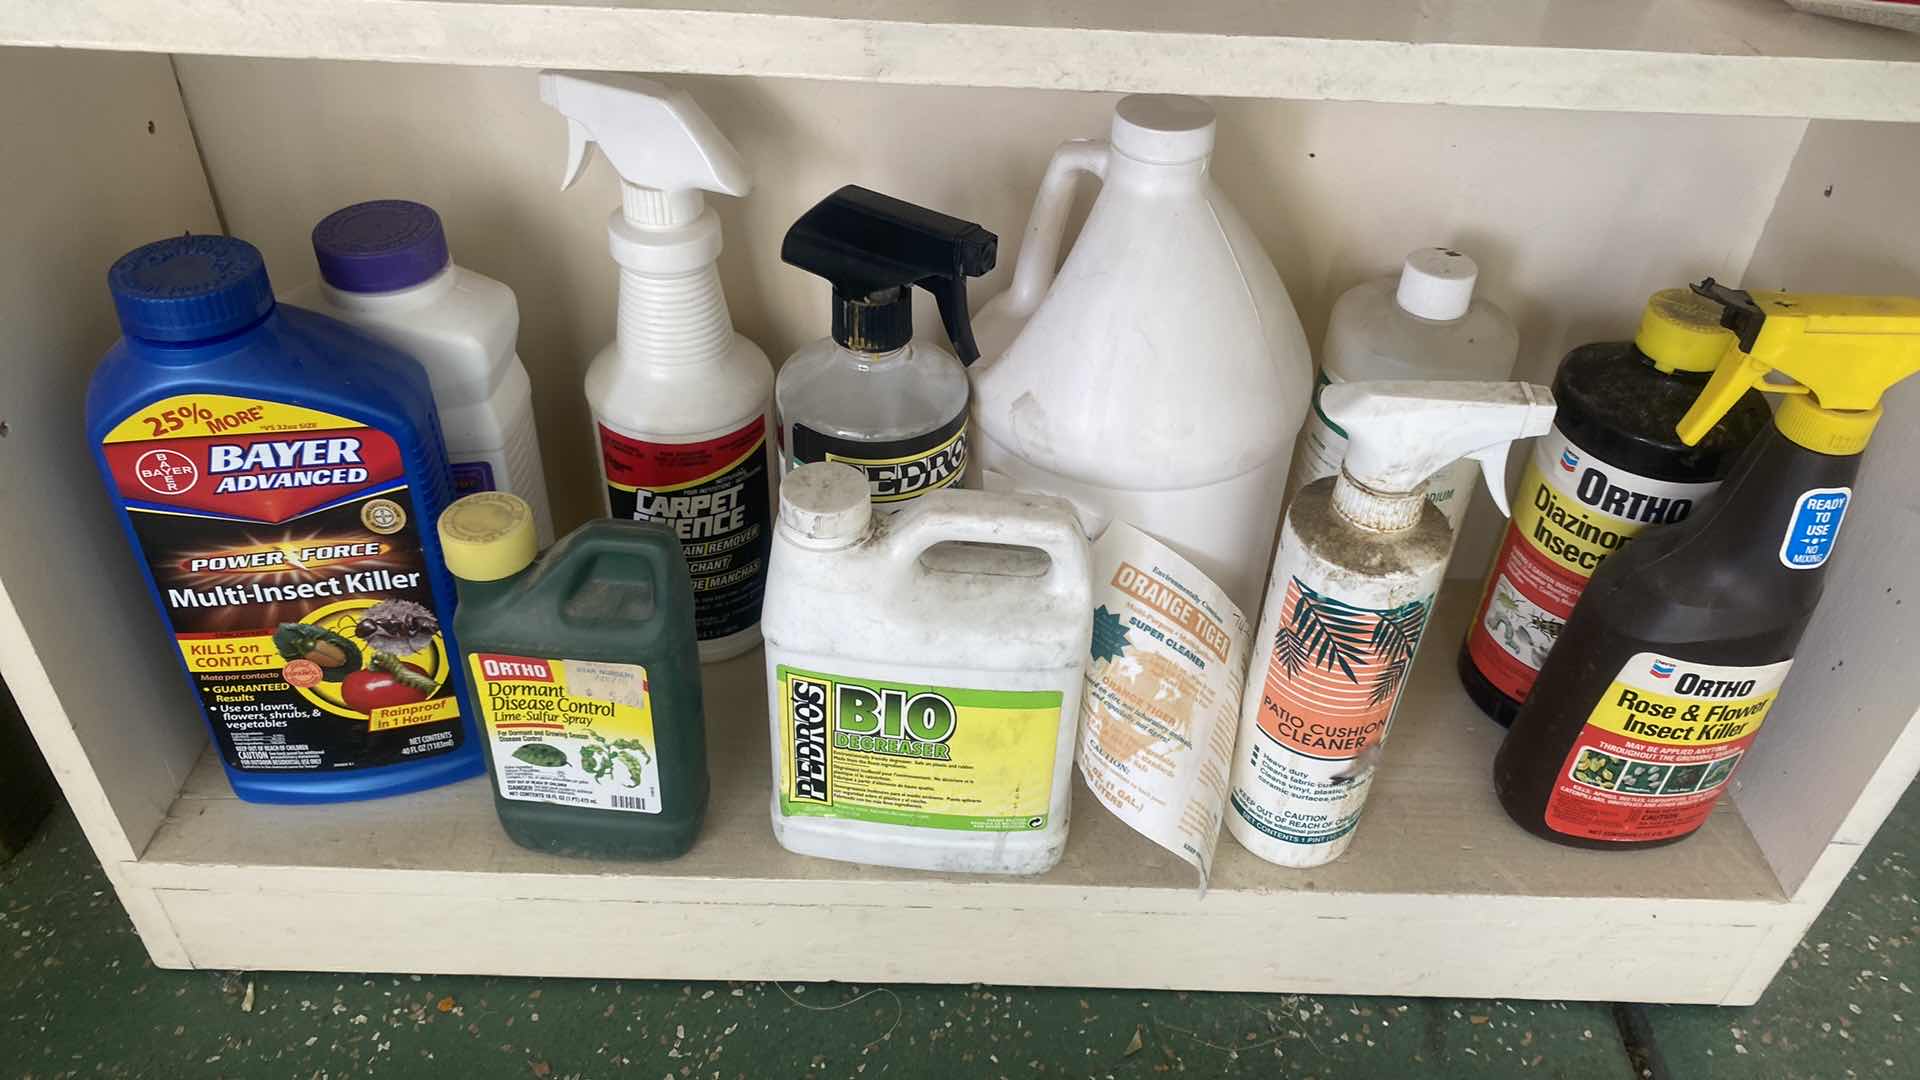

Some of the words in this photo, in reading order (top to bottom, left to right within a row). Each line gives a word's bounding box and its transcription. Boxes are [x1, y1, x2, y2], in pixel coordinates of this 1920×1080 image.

[143, 402, 213, 437] 25%
[209, 438, 361, 475] BAYER
[141, 466, 193, 478] BAYER
[156, 453, 178, 490] BAYER
[216, 468, 368, 494] ADVANCED
[636, 483, 745, 518] CARPET
[1576, 467, 1693, 525] ORTHO
[1806, 497, 1846, 510] READY
[1815, 512, 1831, 523] TO
[1806, 524, 1831, 536] USE
[191, 551, 285, 572] POWER
[301, 543, 380, 561] FORCE
[1792, 554, 1824, 563] MIXING
[1806, 546, 1820, 554] NO
[168, 577, 342, 608] Multi-Insect
[347, 570, 421, 593] Killer
[1118, 567, 1194, 625] ORANGE
[191, 644, 235, 656] KILLS
[239, 645, 260, 654] on
[1128, 616, 1165, 642] SUPER
[1166, 638, 1207, 670] CLEANER
[195, 654, 273, 668] CONTACT
[482, 659, 547, 678] ORTHO
[241, 672, 279, 680] contacto
[1674, 672, 1756, 698] ORTHO
[212, 682, 290, 694] GUARANTEED
[488, 682, 565, 698] Dormant
[216, 694, 255, 703] Results
[220, 704, 241, 713] Use
[243, 704, 259, 712] on
[260, 702, 298, 712] lawns,
[492, 697, 554, 711] Disease
[557, 697, 616, 717] Control
[1616, 689, 1677, 720] Rose
[1680, 704, 1700, 724] &
[1704, 697, 1769, 723] Flower
[223, 711, 269, 721] flowers,
[269, 710, 311, 720] shrubs,
[312, 708, 321, 718] &
[381, 700, 447, 718] Rainproof
[494, 710, 559, 723] Lime-Sulfur
[562, 714, 593, 727] Spray
[835, 682, 957, 742] BIO
[1264, 695, 1304, 729] PATIO
[1310, 718, 1387, 738] CUSHION
[226, 720, 288, 731] vegetables
[402, 714, 433, 725] Hour
[1622, 714, 1693, 741] Insect
[1696, 721, 1749, 741] Killer
[790, 679, 826, 801] PEDRO'S
[834, 731, 952, 760] DEGREASER
[1278, 723, 1366, 750] CLEANER
[238, 751, 269, 760] CAUTION
[1599, 742, 1657, 760] THROUGHOUT
[1625, 742, 1646, 752] MAY
[1646, 746, 1660, 754] BE
[1262, 760, 1288, 780] Cleans
[1290, 776, 1318, 788] fabric
[1263, 753, 1287, 772] Heavy
[1288, 768, 1309, 780] duty
[1259, 767, 1287, 787] Cleans
[1256, 804, 1273, 818] OUT
[1274, 814, 1288, 824] OF
[1288, 819, 1321, 830] REACH
[1284, 810, 1328, 822] CAUTION
[1256, 823, 1300, 842] CONTENTS
